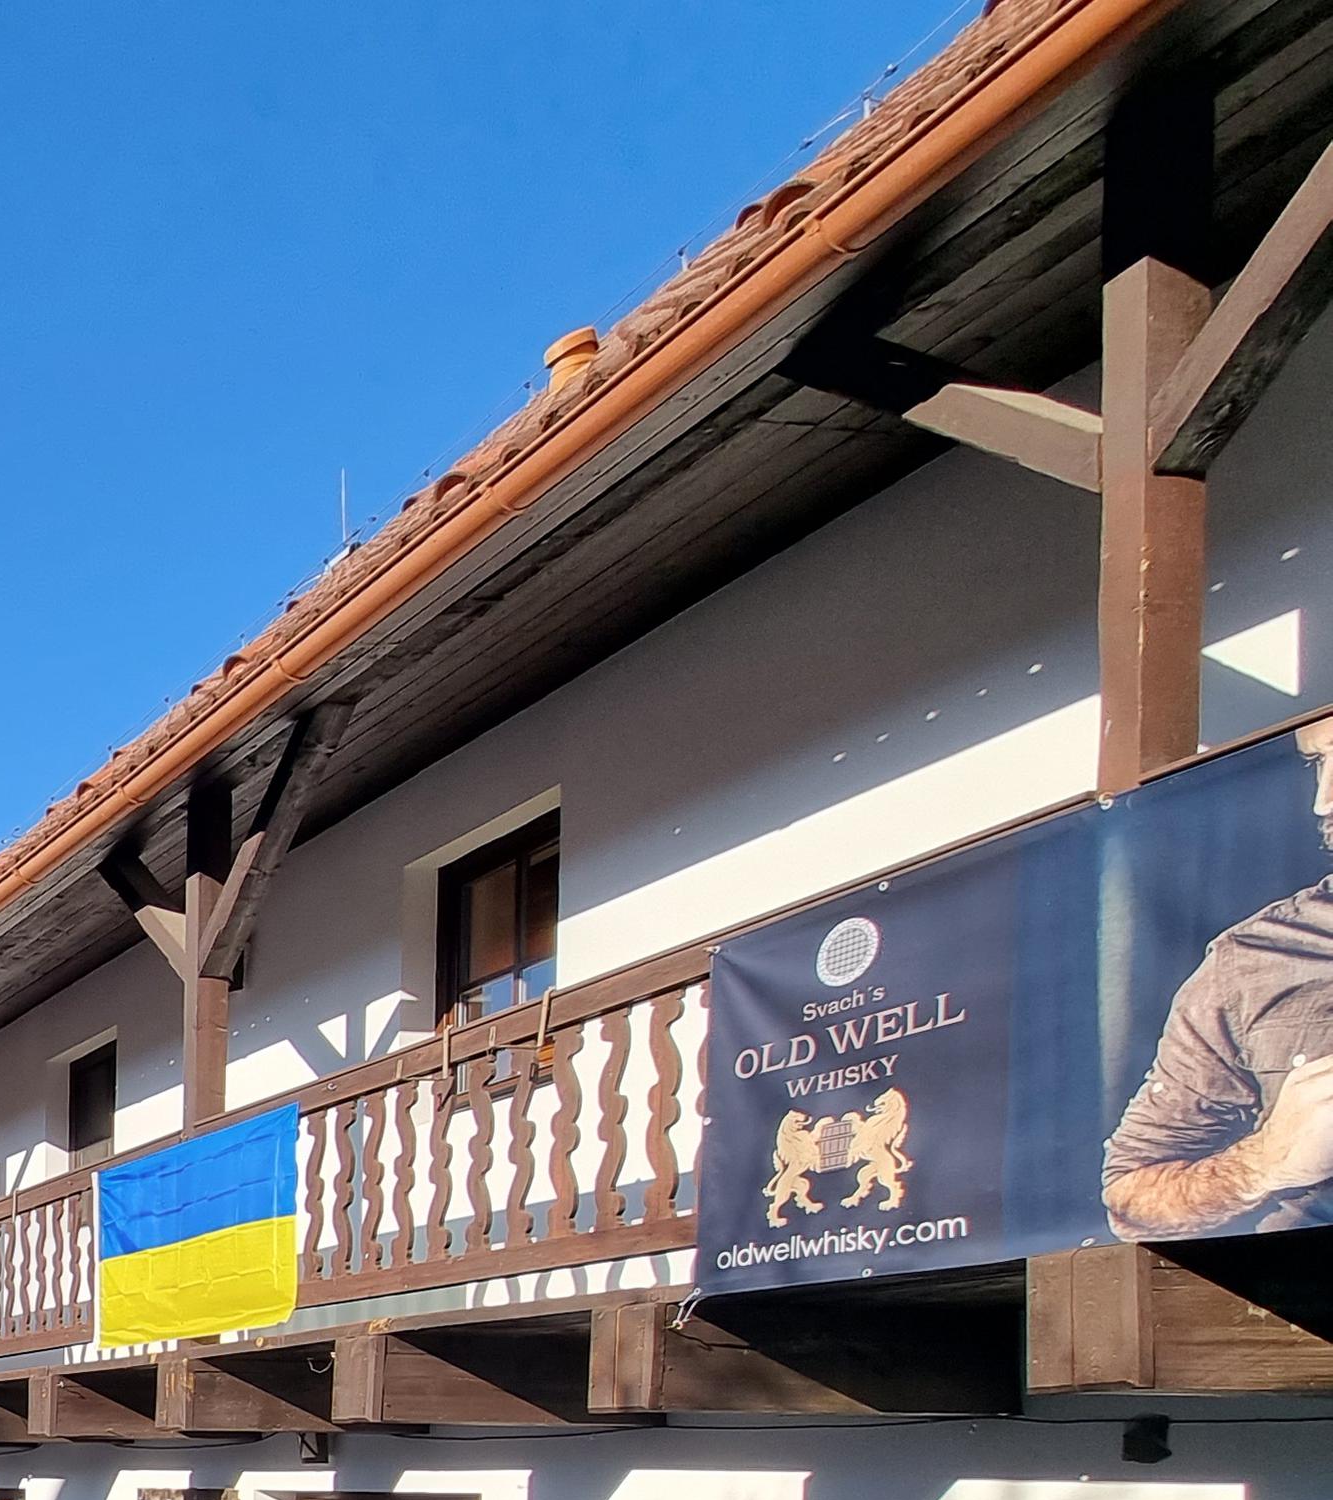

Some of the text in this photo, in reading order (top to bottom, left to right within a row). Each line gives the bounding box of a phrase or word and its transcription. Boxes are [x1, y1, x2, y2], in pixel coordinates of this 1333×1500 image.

[735, 992, 966, 1079] OLD WELL
[785, 1054, 900, 1099] WHISKY
[716, 1216, 969, 1270] oldwellwhisky.com
